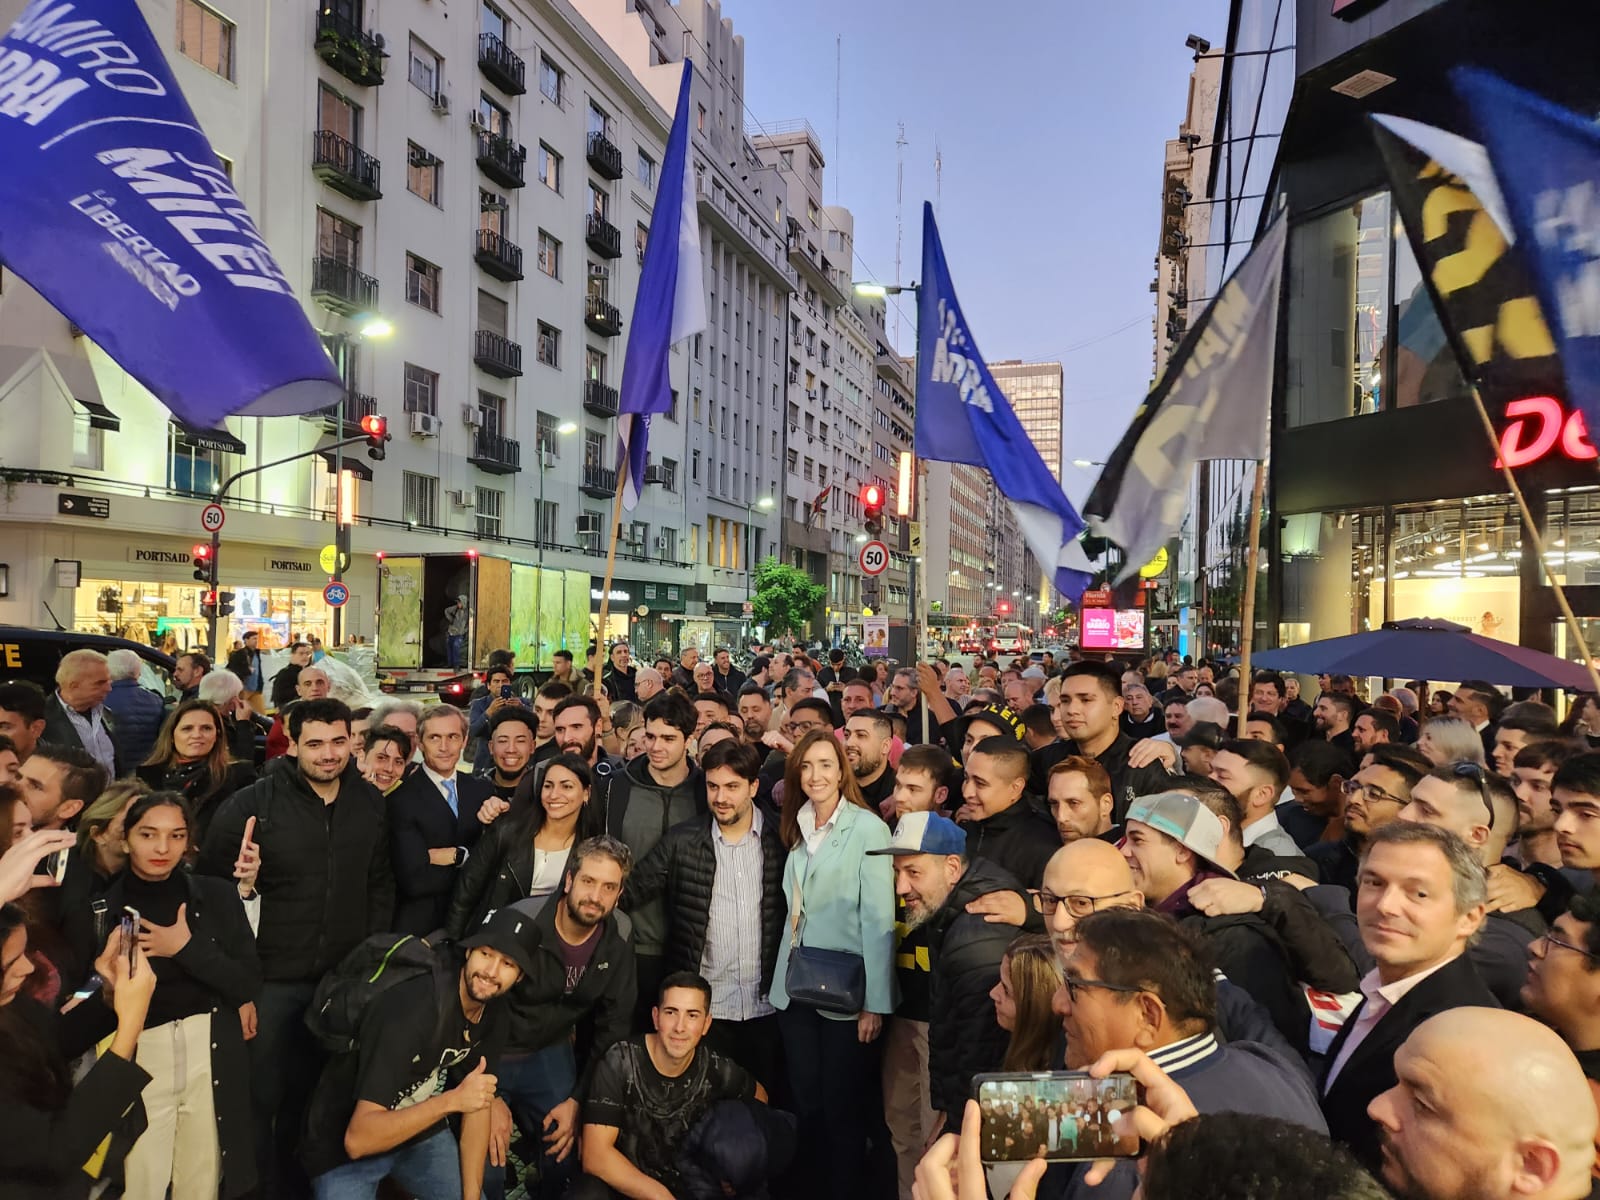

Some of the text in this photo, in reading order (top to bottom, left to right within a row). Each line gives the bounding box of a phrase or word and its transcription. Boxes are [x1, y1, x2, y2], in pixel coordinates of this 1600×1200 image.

[95, 147, 288, 295] MILEI
[69, 194, 201, 297] LIBERTAD
[198, 439, 234, 452] PORTSAID
[206, 512, 220, 524] 50
[135, 549, 190, 564] PORTSAID
[866, 551, 883, 565] 50
[271, 559, 312, 572] PORTSAID
[0, 643, 22, 667] E
